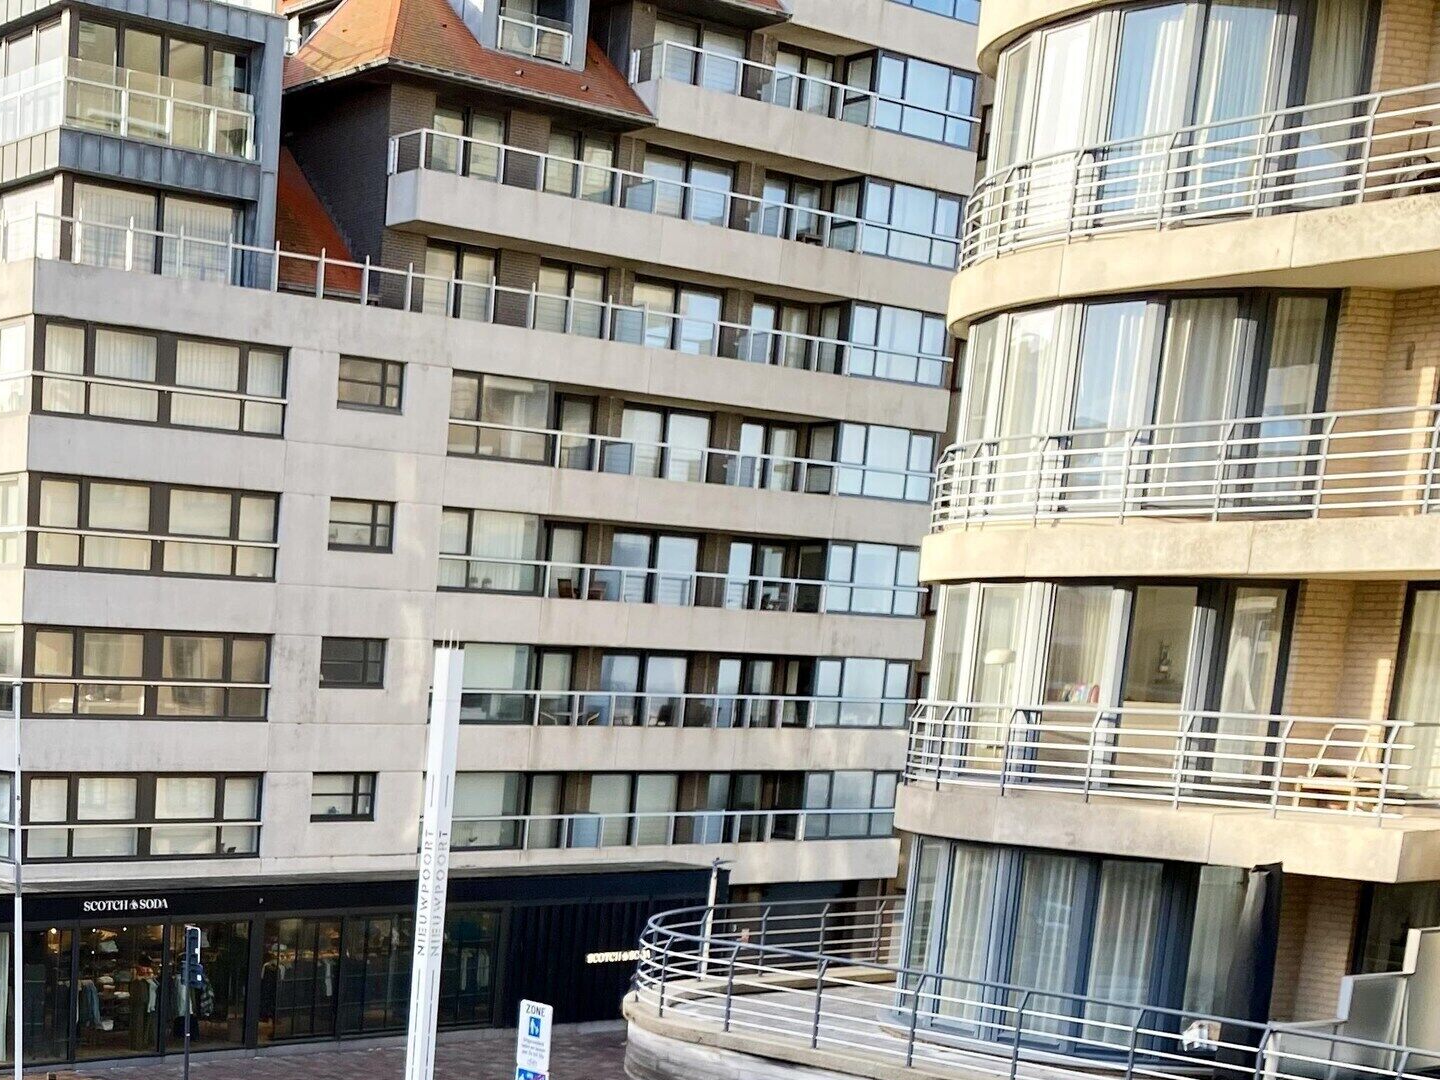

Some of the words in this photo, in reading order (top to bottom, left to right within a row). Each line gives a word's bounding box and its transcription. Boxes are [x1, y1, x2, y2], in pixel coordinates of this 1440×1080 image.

[83, 900, 128, 911] SCOTCH
[139, 898, 168, 909] SODA
[417, 829, 434, 956] NIEUWPOORT
[430, 830, 448, 957] NIEUWPOORT
[525, 1003, 546, 1018] ZONE
